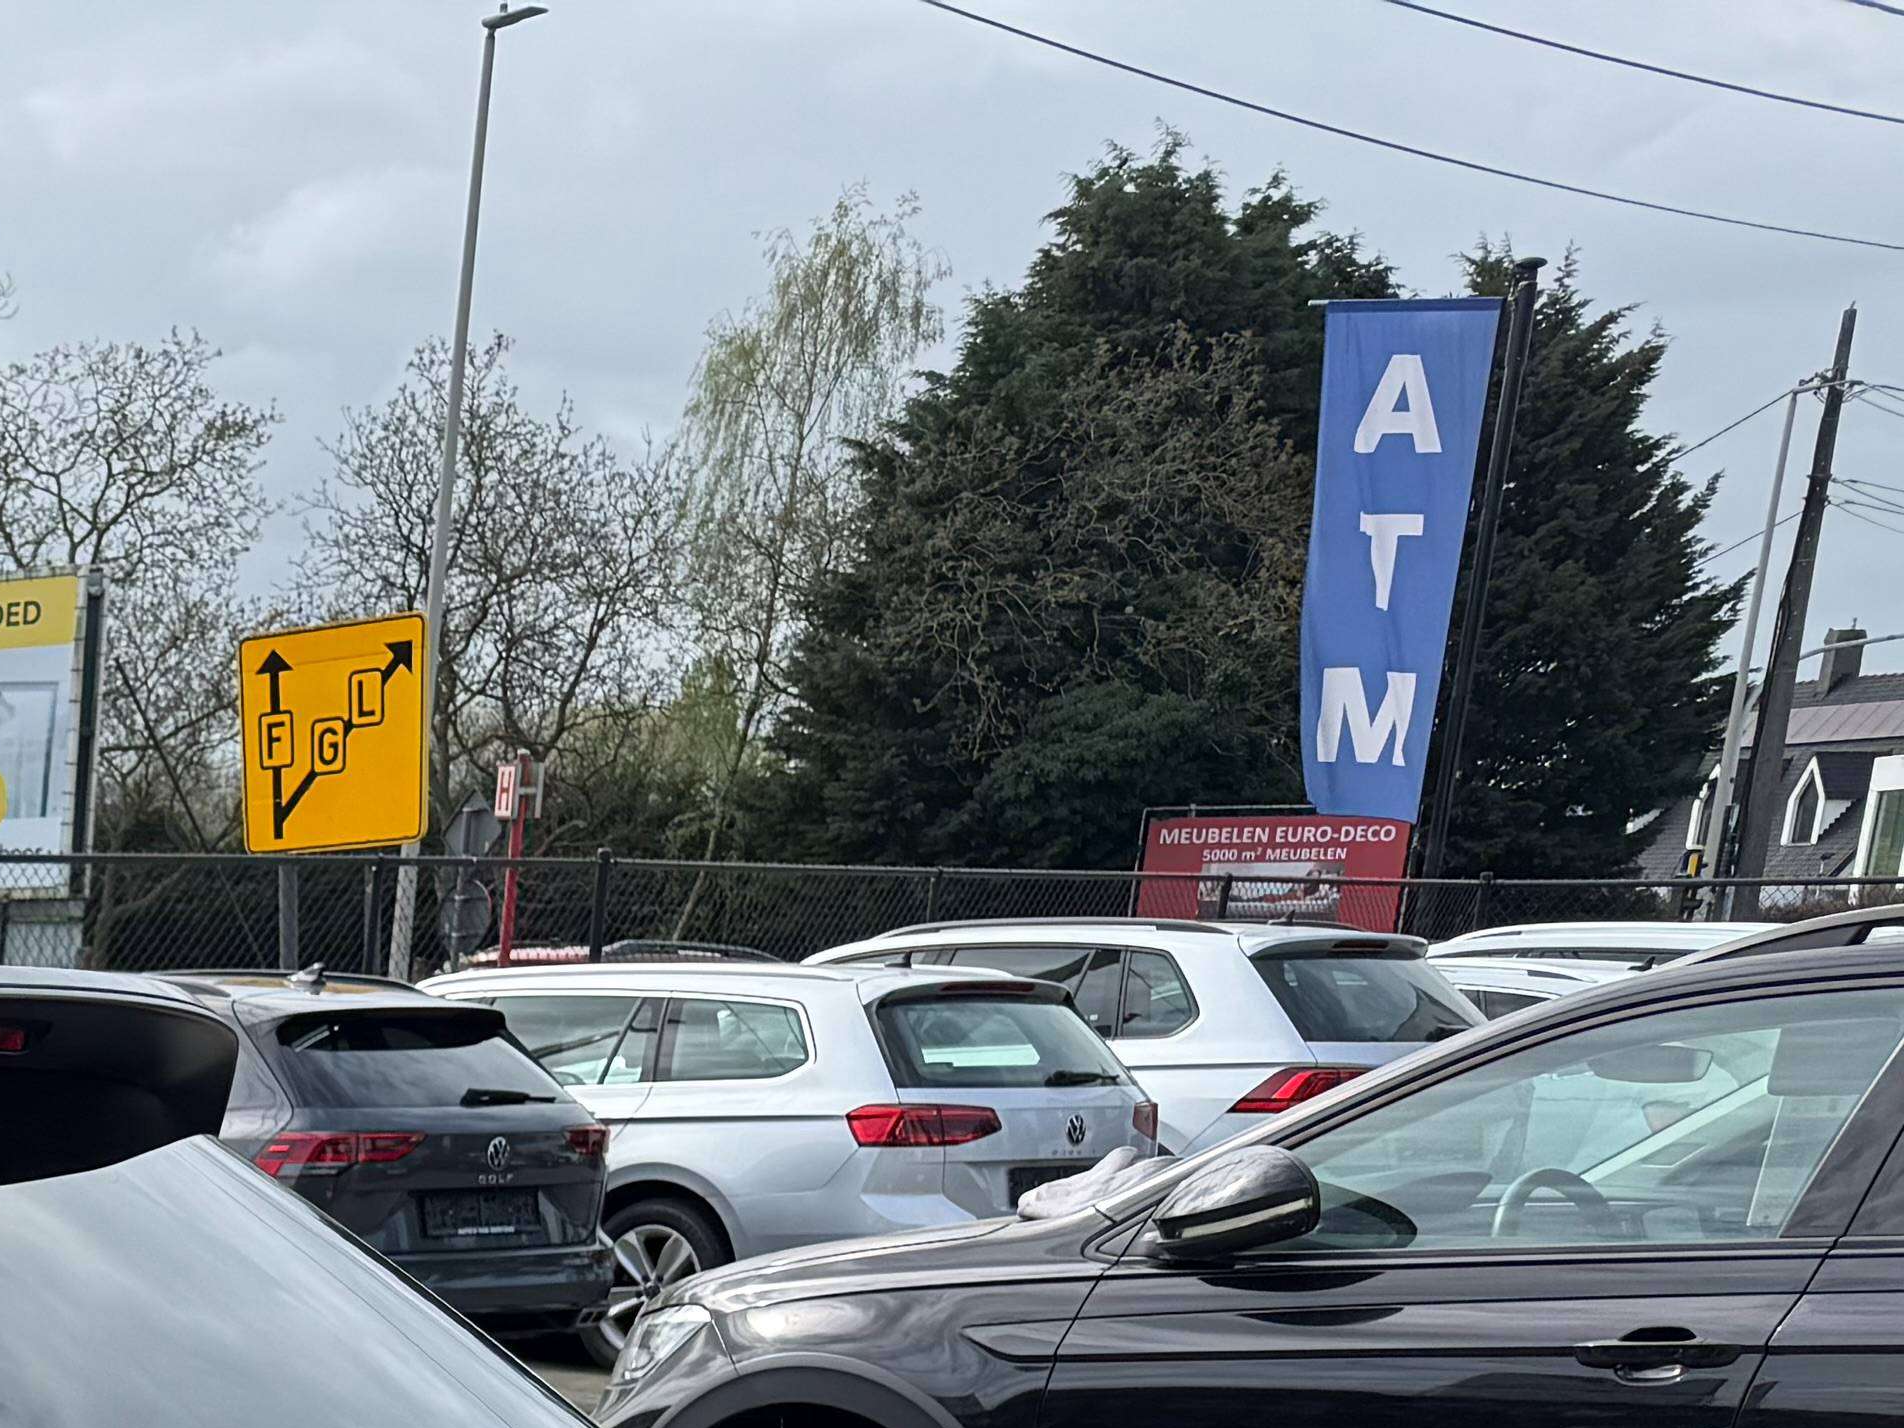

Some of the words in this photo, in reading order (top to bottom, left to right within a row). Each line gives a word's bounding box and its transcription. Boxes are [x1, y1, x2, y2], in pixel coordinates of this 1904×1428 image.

[1316, 353, 1442, 767] ATM
[357, 679, 375, 718] L
[267, 721, 285, 760] F
[318, 727, 339, 766] G
[1159, 827, 1269, 845] MEUBELEN
[1275, 825, 1397, 843] EURO-DECO
[1202, 848, 1237, 862] 5000
[1265, 847, 1347, 860] MEUBELEN
[478, 1173, 514, 1185] GOLF
